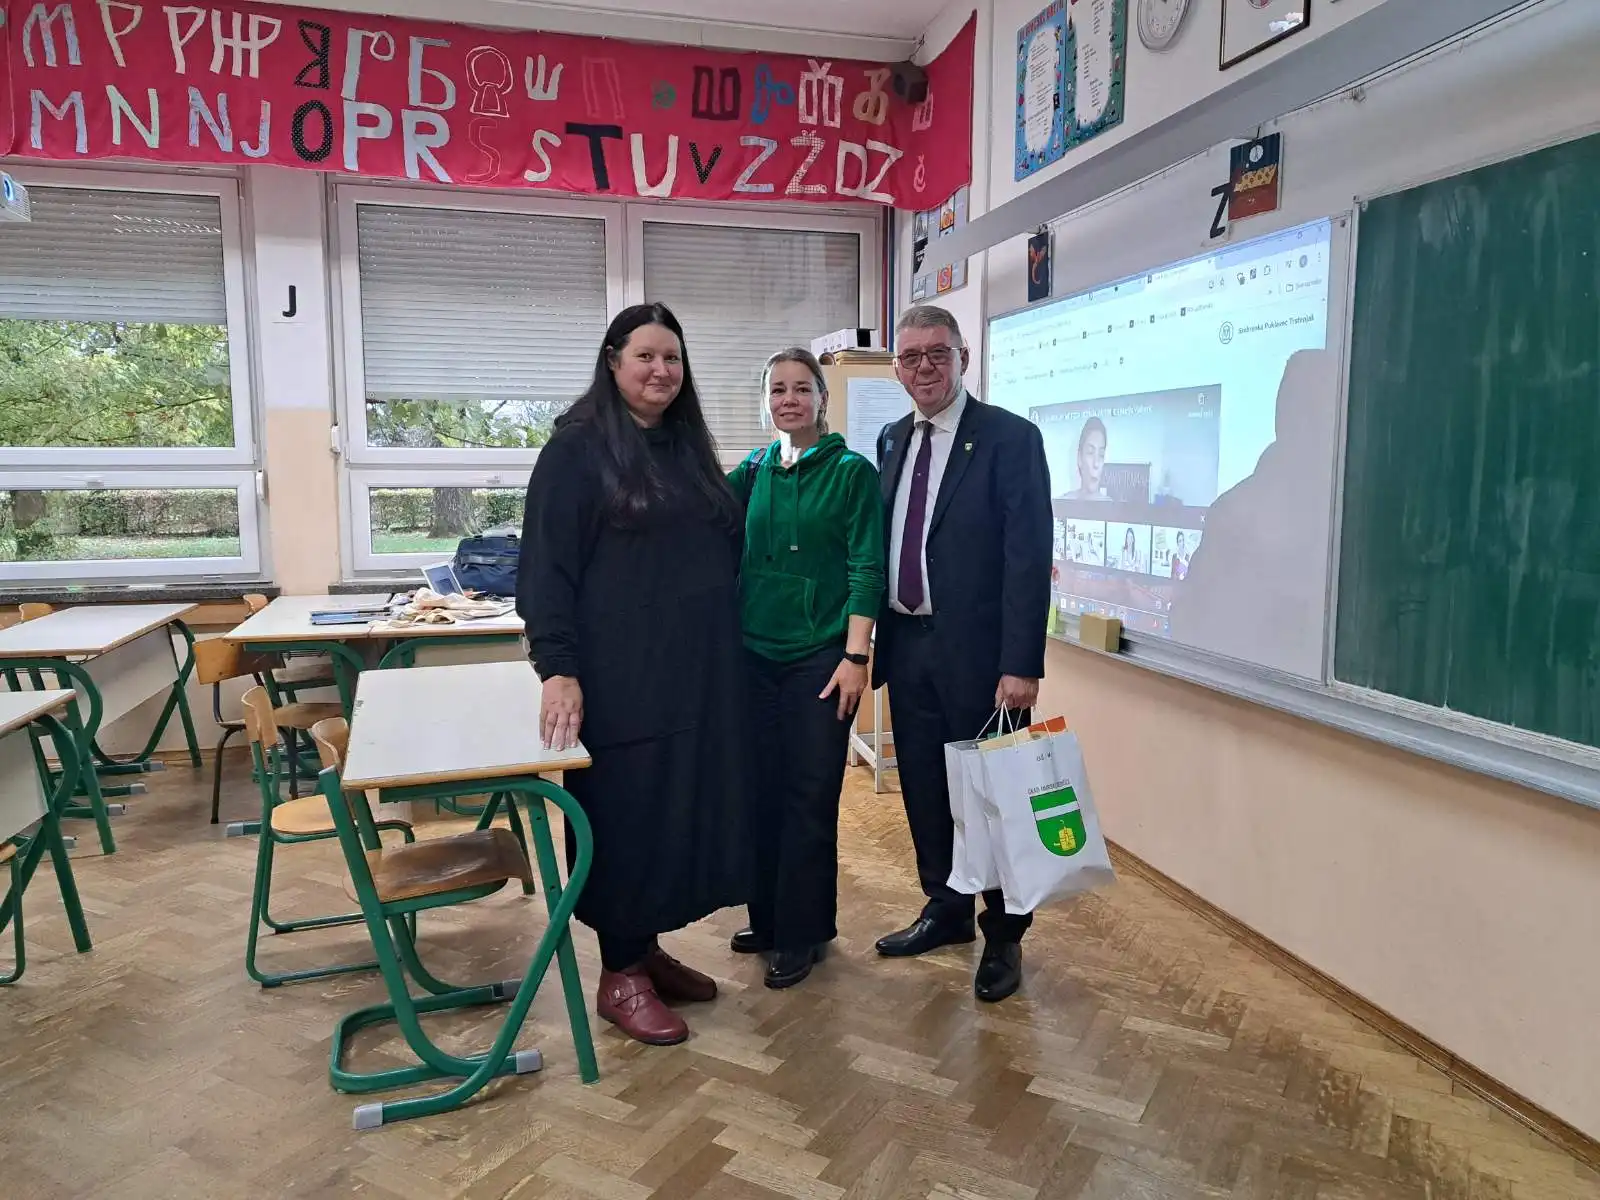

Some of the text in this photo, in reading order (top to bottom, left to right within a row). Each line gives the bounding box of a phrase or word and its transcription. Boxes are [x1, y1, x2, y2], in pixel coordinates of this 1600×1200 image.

[30, 89, 88, 153] M
[106, 85, 159, 149] N
[291, 100, 333, 163] O
[343, 100, 393, 171] P
[401, 109, 453, 183] R
[464, 118, 500, 183] S
[524, 129, 562, 182] S
[565, 122, 623, 190] T
[631, 133, 679, 197] U
[689, 141, 722, 184] V
[733, 136, 778, 192] Z
[785, 129, 829, 195] Ž
[836, 138, 904, 204] DZ
[282, 285, 297, 318] J
